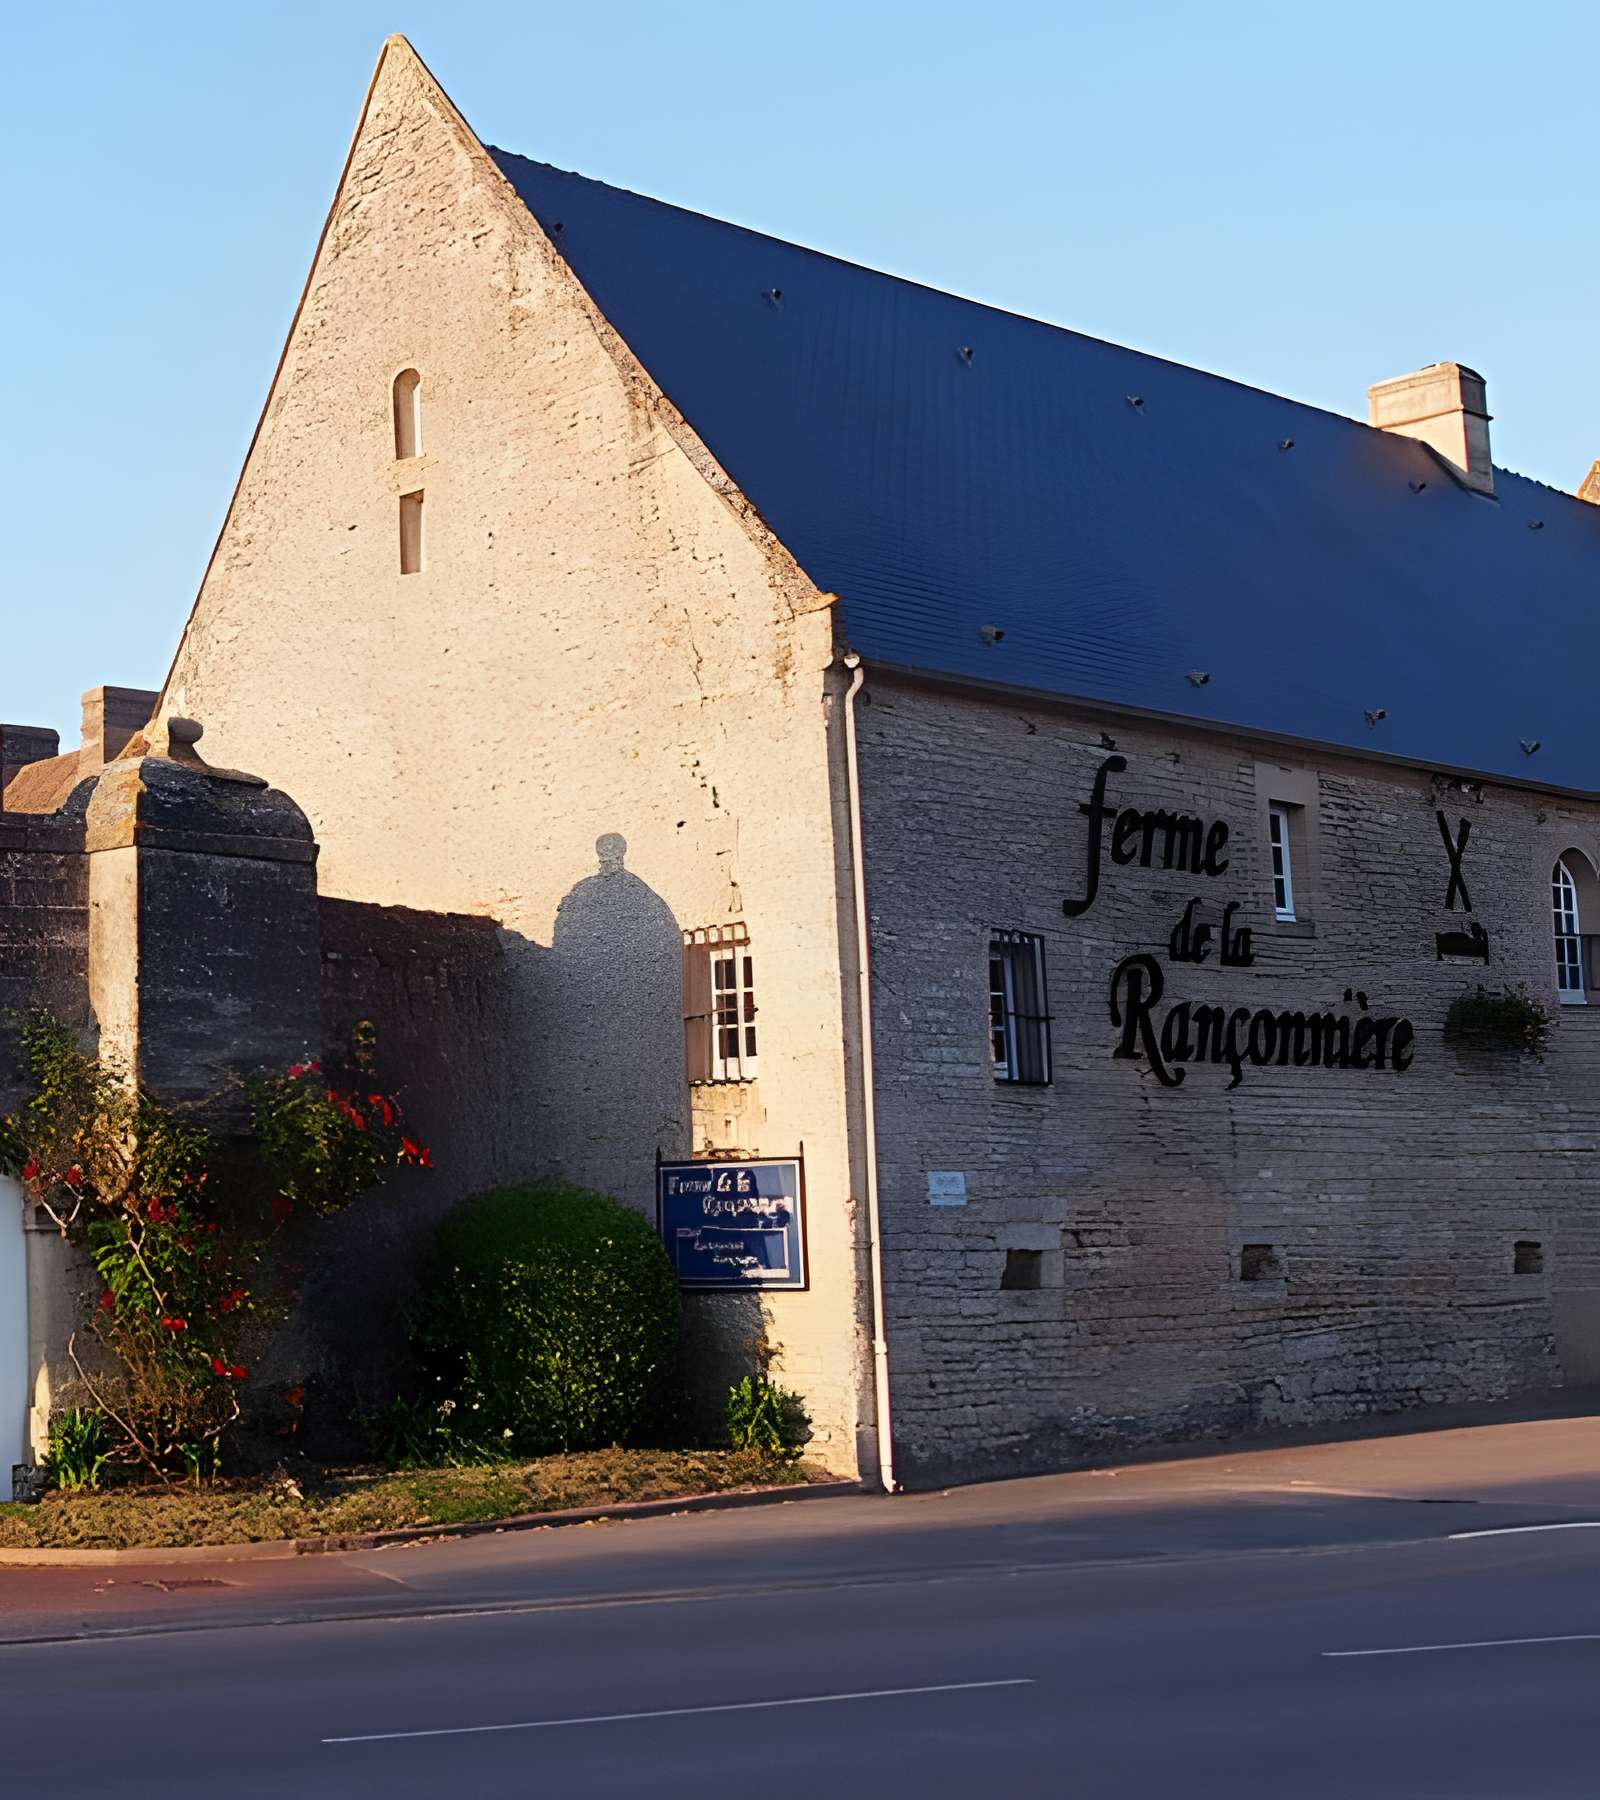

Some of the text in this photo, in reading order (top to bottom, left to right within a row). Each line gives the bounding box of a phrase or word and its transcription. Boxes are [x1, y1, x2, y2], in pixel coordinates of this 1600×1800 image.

[1168, 896, 1256, 968] de la
[1110, 954, 1415, 1090] Rançonnière
